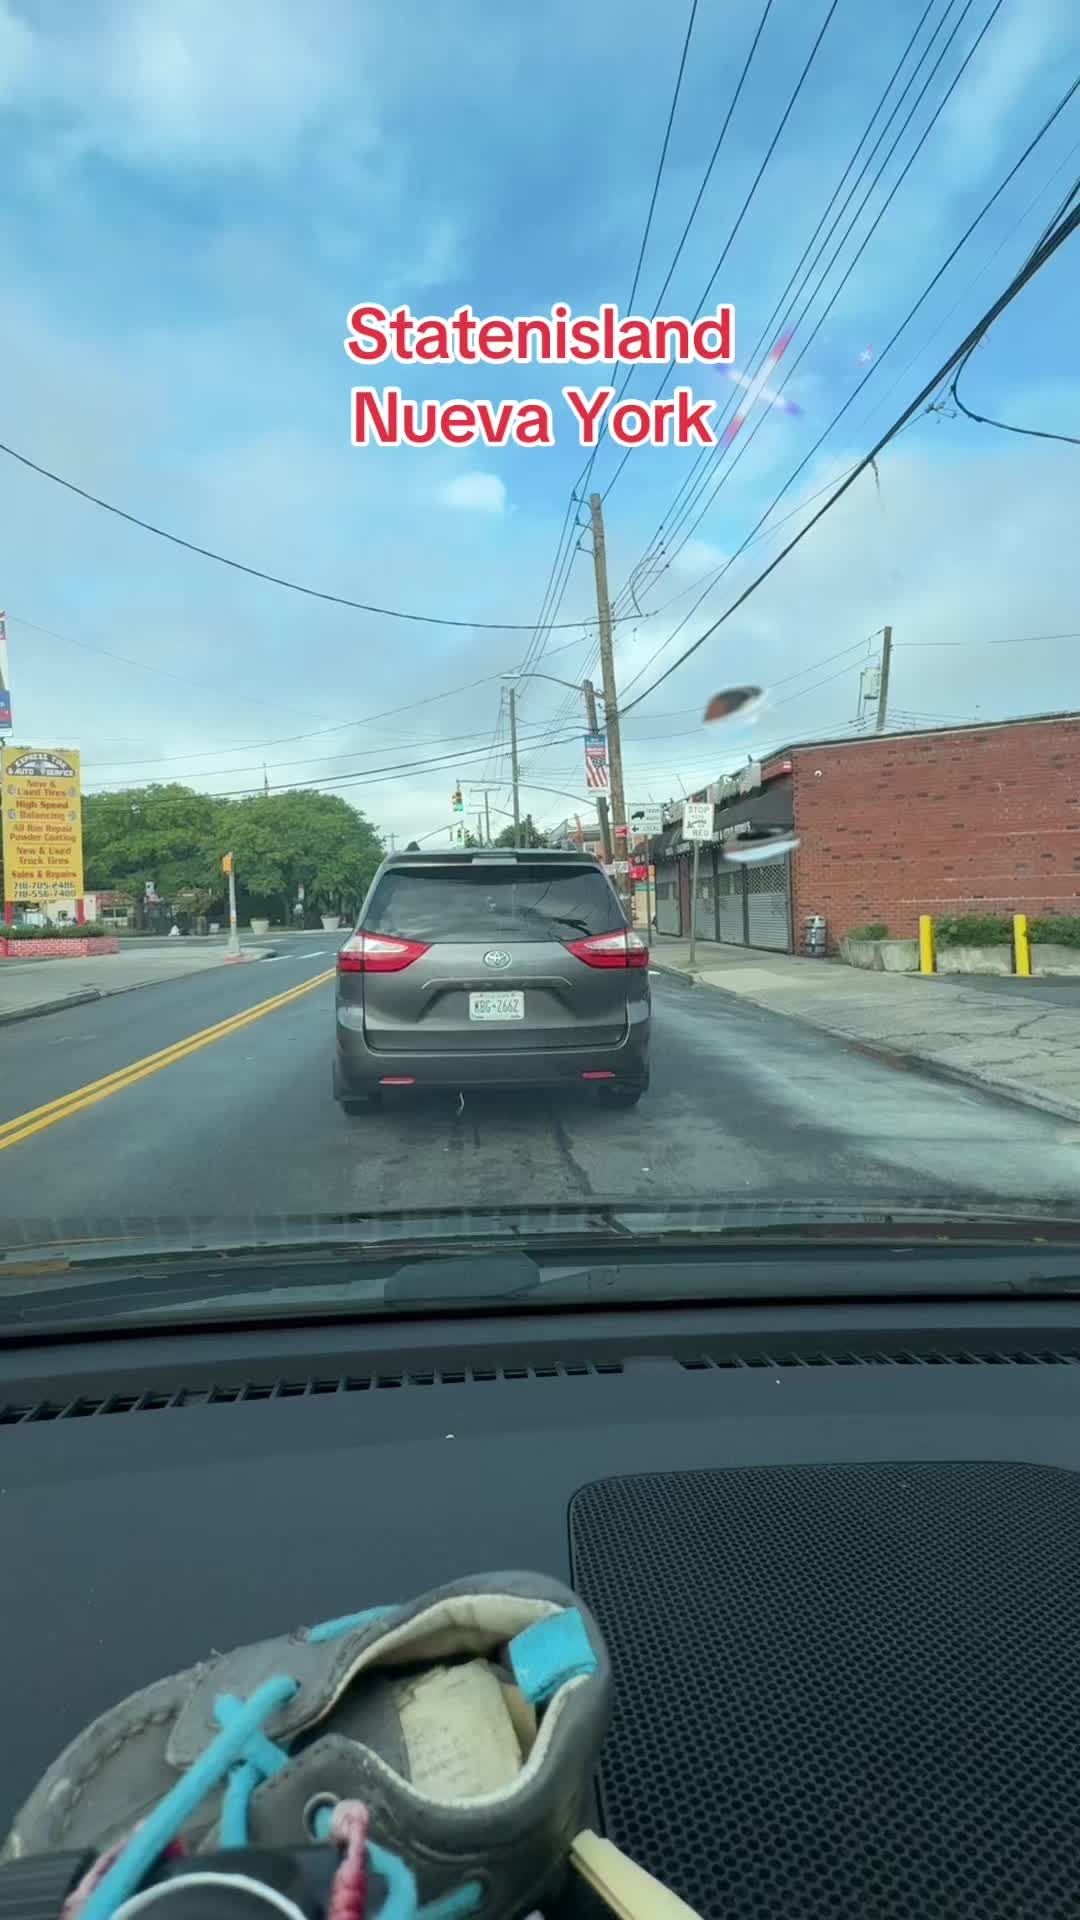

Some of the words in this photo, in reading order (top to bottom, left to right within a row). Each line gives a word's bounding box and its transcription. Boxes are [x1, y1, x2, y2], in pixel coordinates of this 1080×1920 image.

[27, 780, 46, 788] New
[17, 788, 41, 796] Used
[44, 789, 66, 797] Tires
[16, 800, 38, 809] High
[40, 801, 69, 810] Speed
[687, 806, 710, 814] STOP
[20, 810, 65, 820] Balancing
[14, 824, 25, 832] All
[27, 824, 43, 832] Rim
[46, 825, 72, 833] Repair
[9, 833, 41, 841] Powder
[44, 833, 77, 842] Coating
[16, 846, 36, 855] New
[39, 847, 45, 855] &
[48, 847, 72, 855] Used
[19, 856, 44, 865] Truck
[47, 856, 70, 865] Tires
[12, 870, 34, 878] Sales
[45, 870, 77, 878] Repairs
